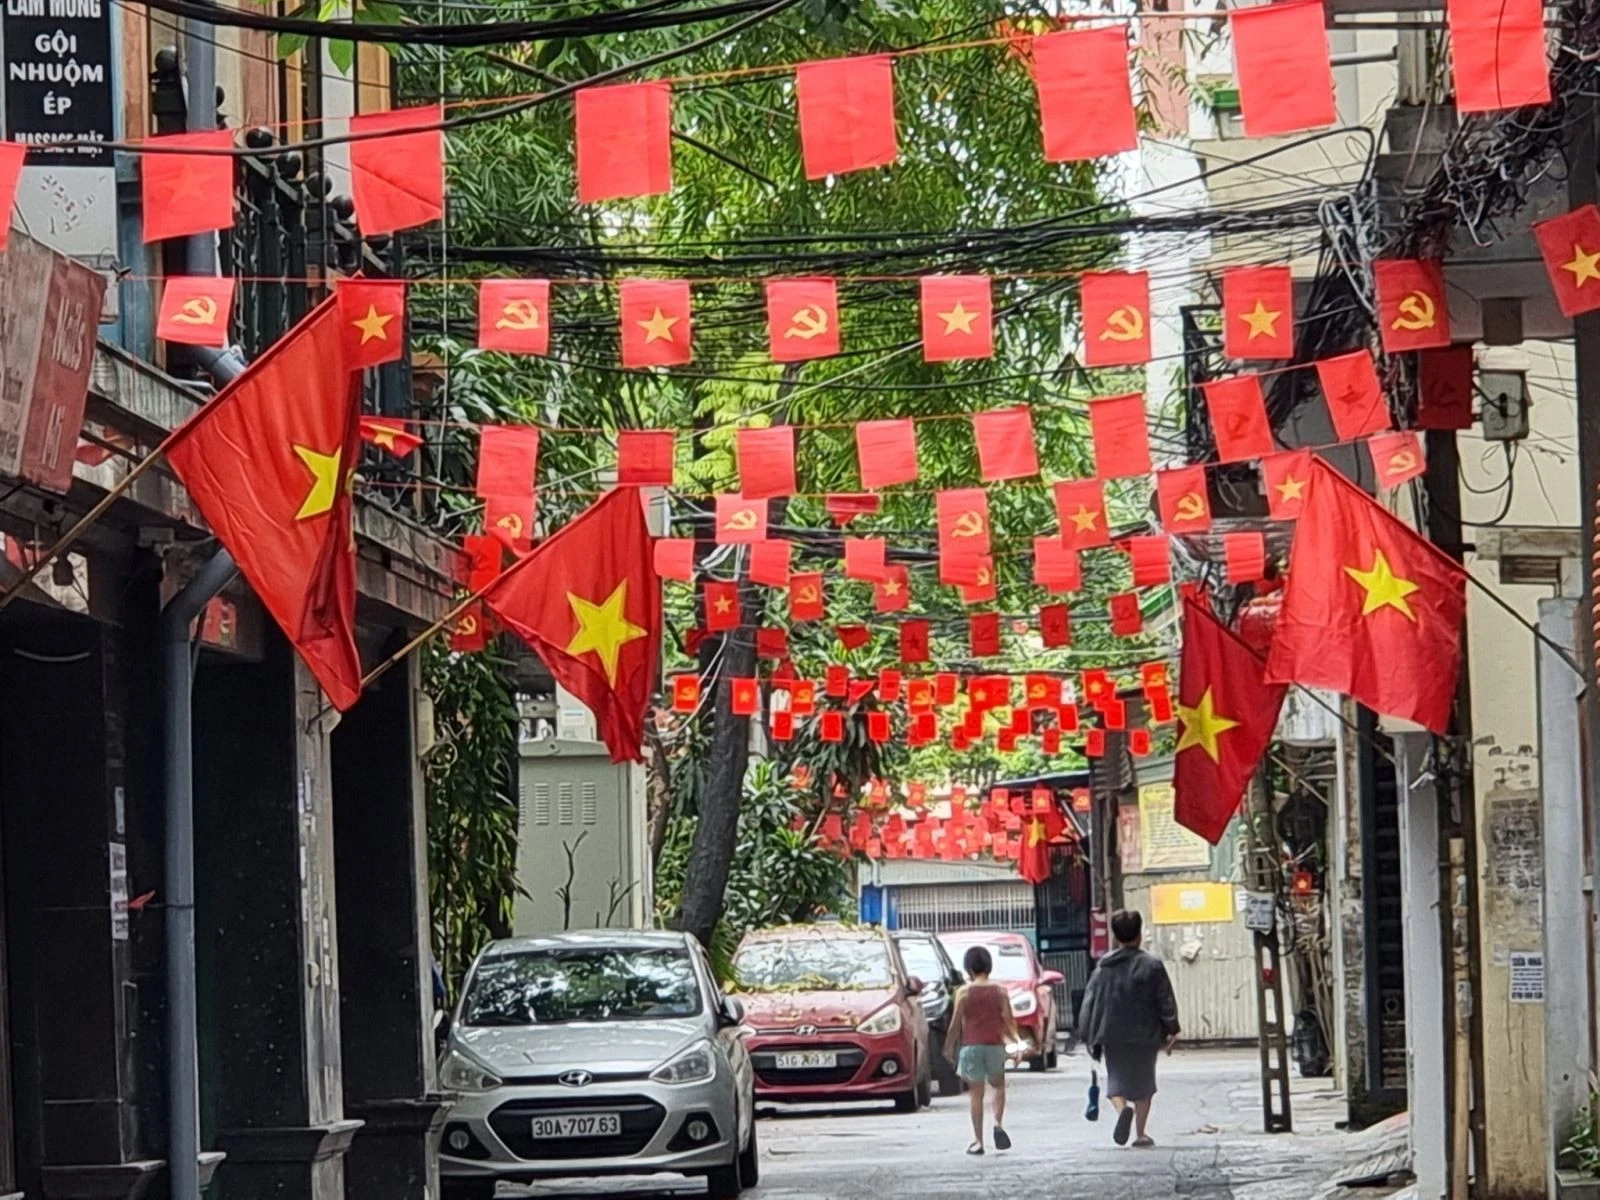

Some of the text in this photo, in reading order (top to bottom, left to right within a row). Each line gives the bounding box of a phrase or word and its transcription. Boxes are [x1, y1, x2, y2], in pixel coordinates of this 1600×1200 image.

[35, 28, 77, 58] GỘI
[9, 58, 104, 87] NHUỘM
[43, 91, 72, 115] ÉP
